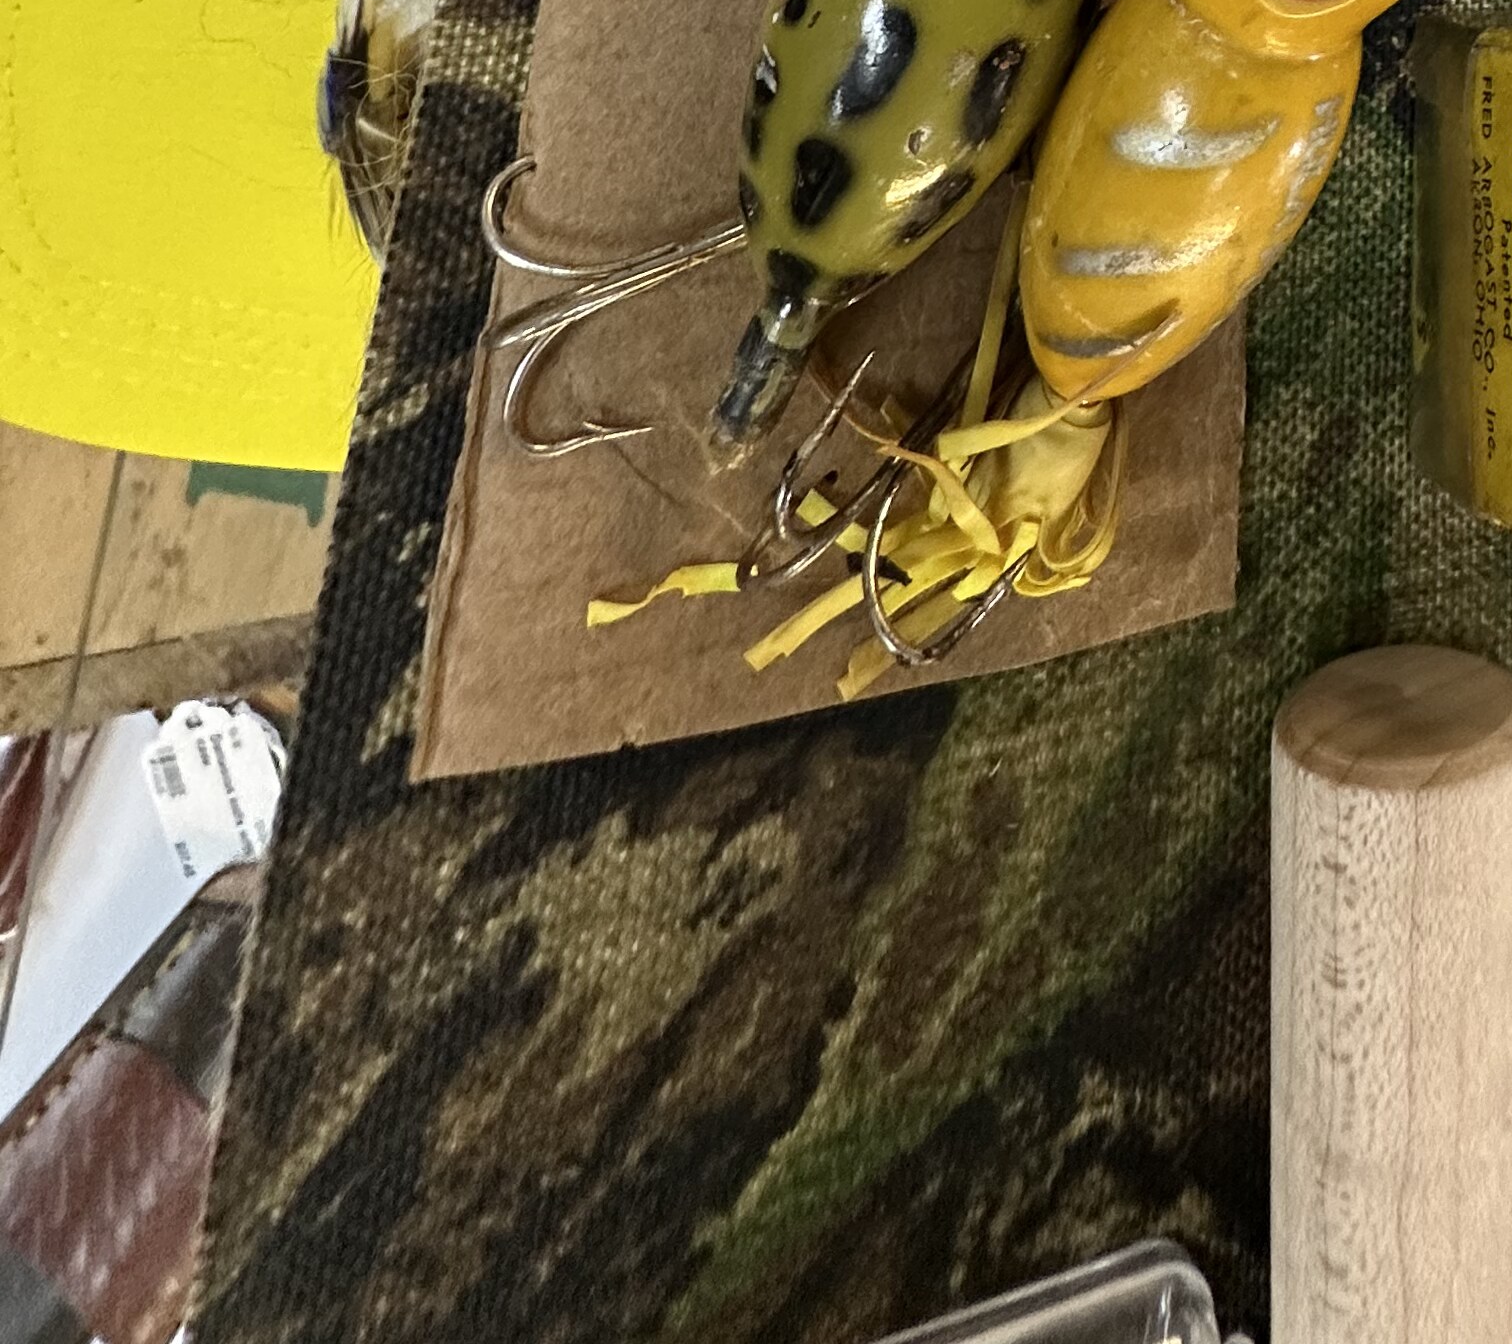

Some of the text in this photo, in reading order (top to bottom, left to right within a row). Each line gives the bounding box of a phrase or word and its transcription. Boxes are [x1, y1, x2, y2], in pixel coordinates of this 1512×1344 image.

[1480, 75, 1494, 139] FRED
[1481, 155, 1497, 313] ARBOGAST
[1471, 279, 1485, 362] OHIO
